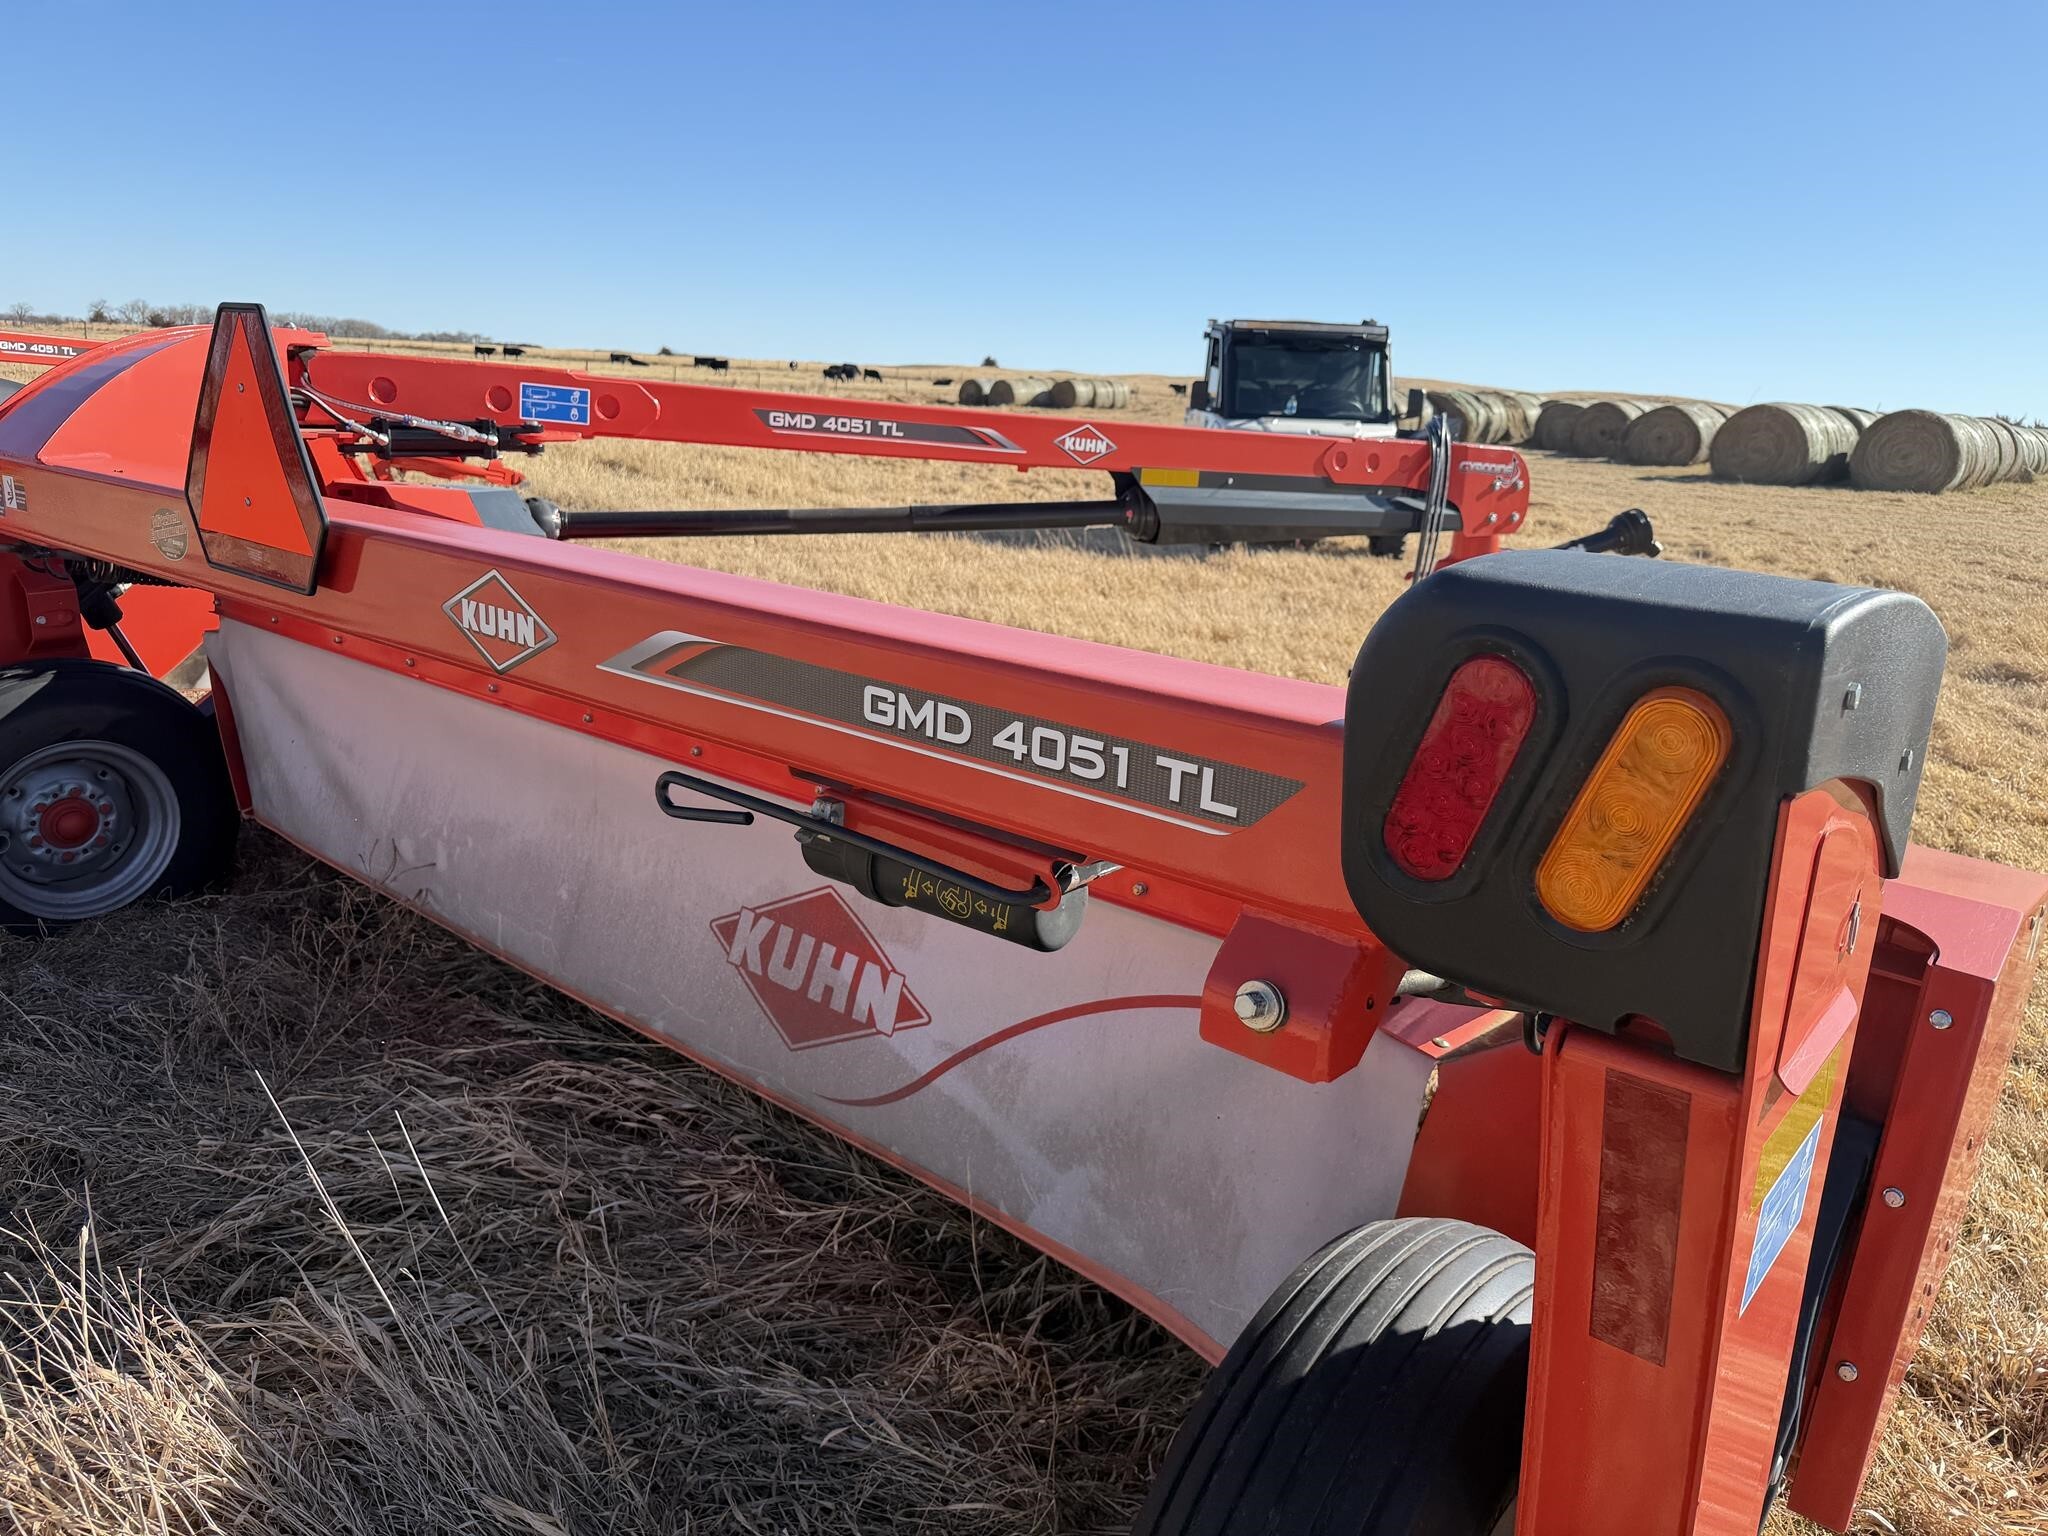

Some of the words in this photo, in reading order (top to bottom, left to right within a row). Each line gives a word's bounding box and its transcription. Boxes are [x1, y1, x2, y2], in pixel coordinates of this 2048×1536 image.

[0, 341, 27, 351] GMD
[30, 343, 58, 354] 4051
[62, 346, 77, 356] TL
[769, 411, 816, 429] GMD
[822, 416, 872, 434] 4051
[878, 421, 904, 437] TL
[1065, 436, 1107, 454] KUHN
[461, 598, 535, 648] KUHN
[863, 685, 972, 745] GMD
[992, 720, 1129, 789] 4051
[1156, 755, 1238, 819] TL
[726, 906, 906, 1037] KUHN
